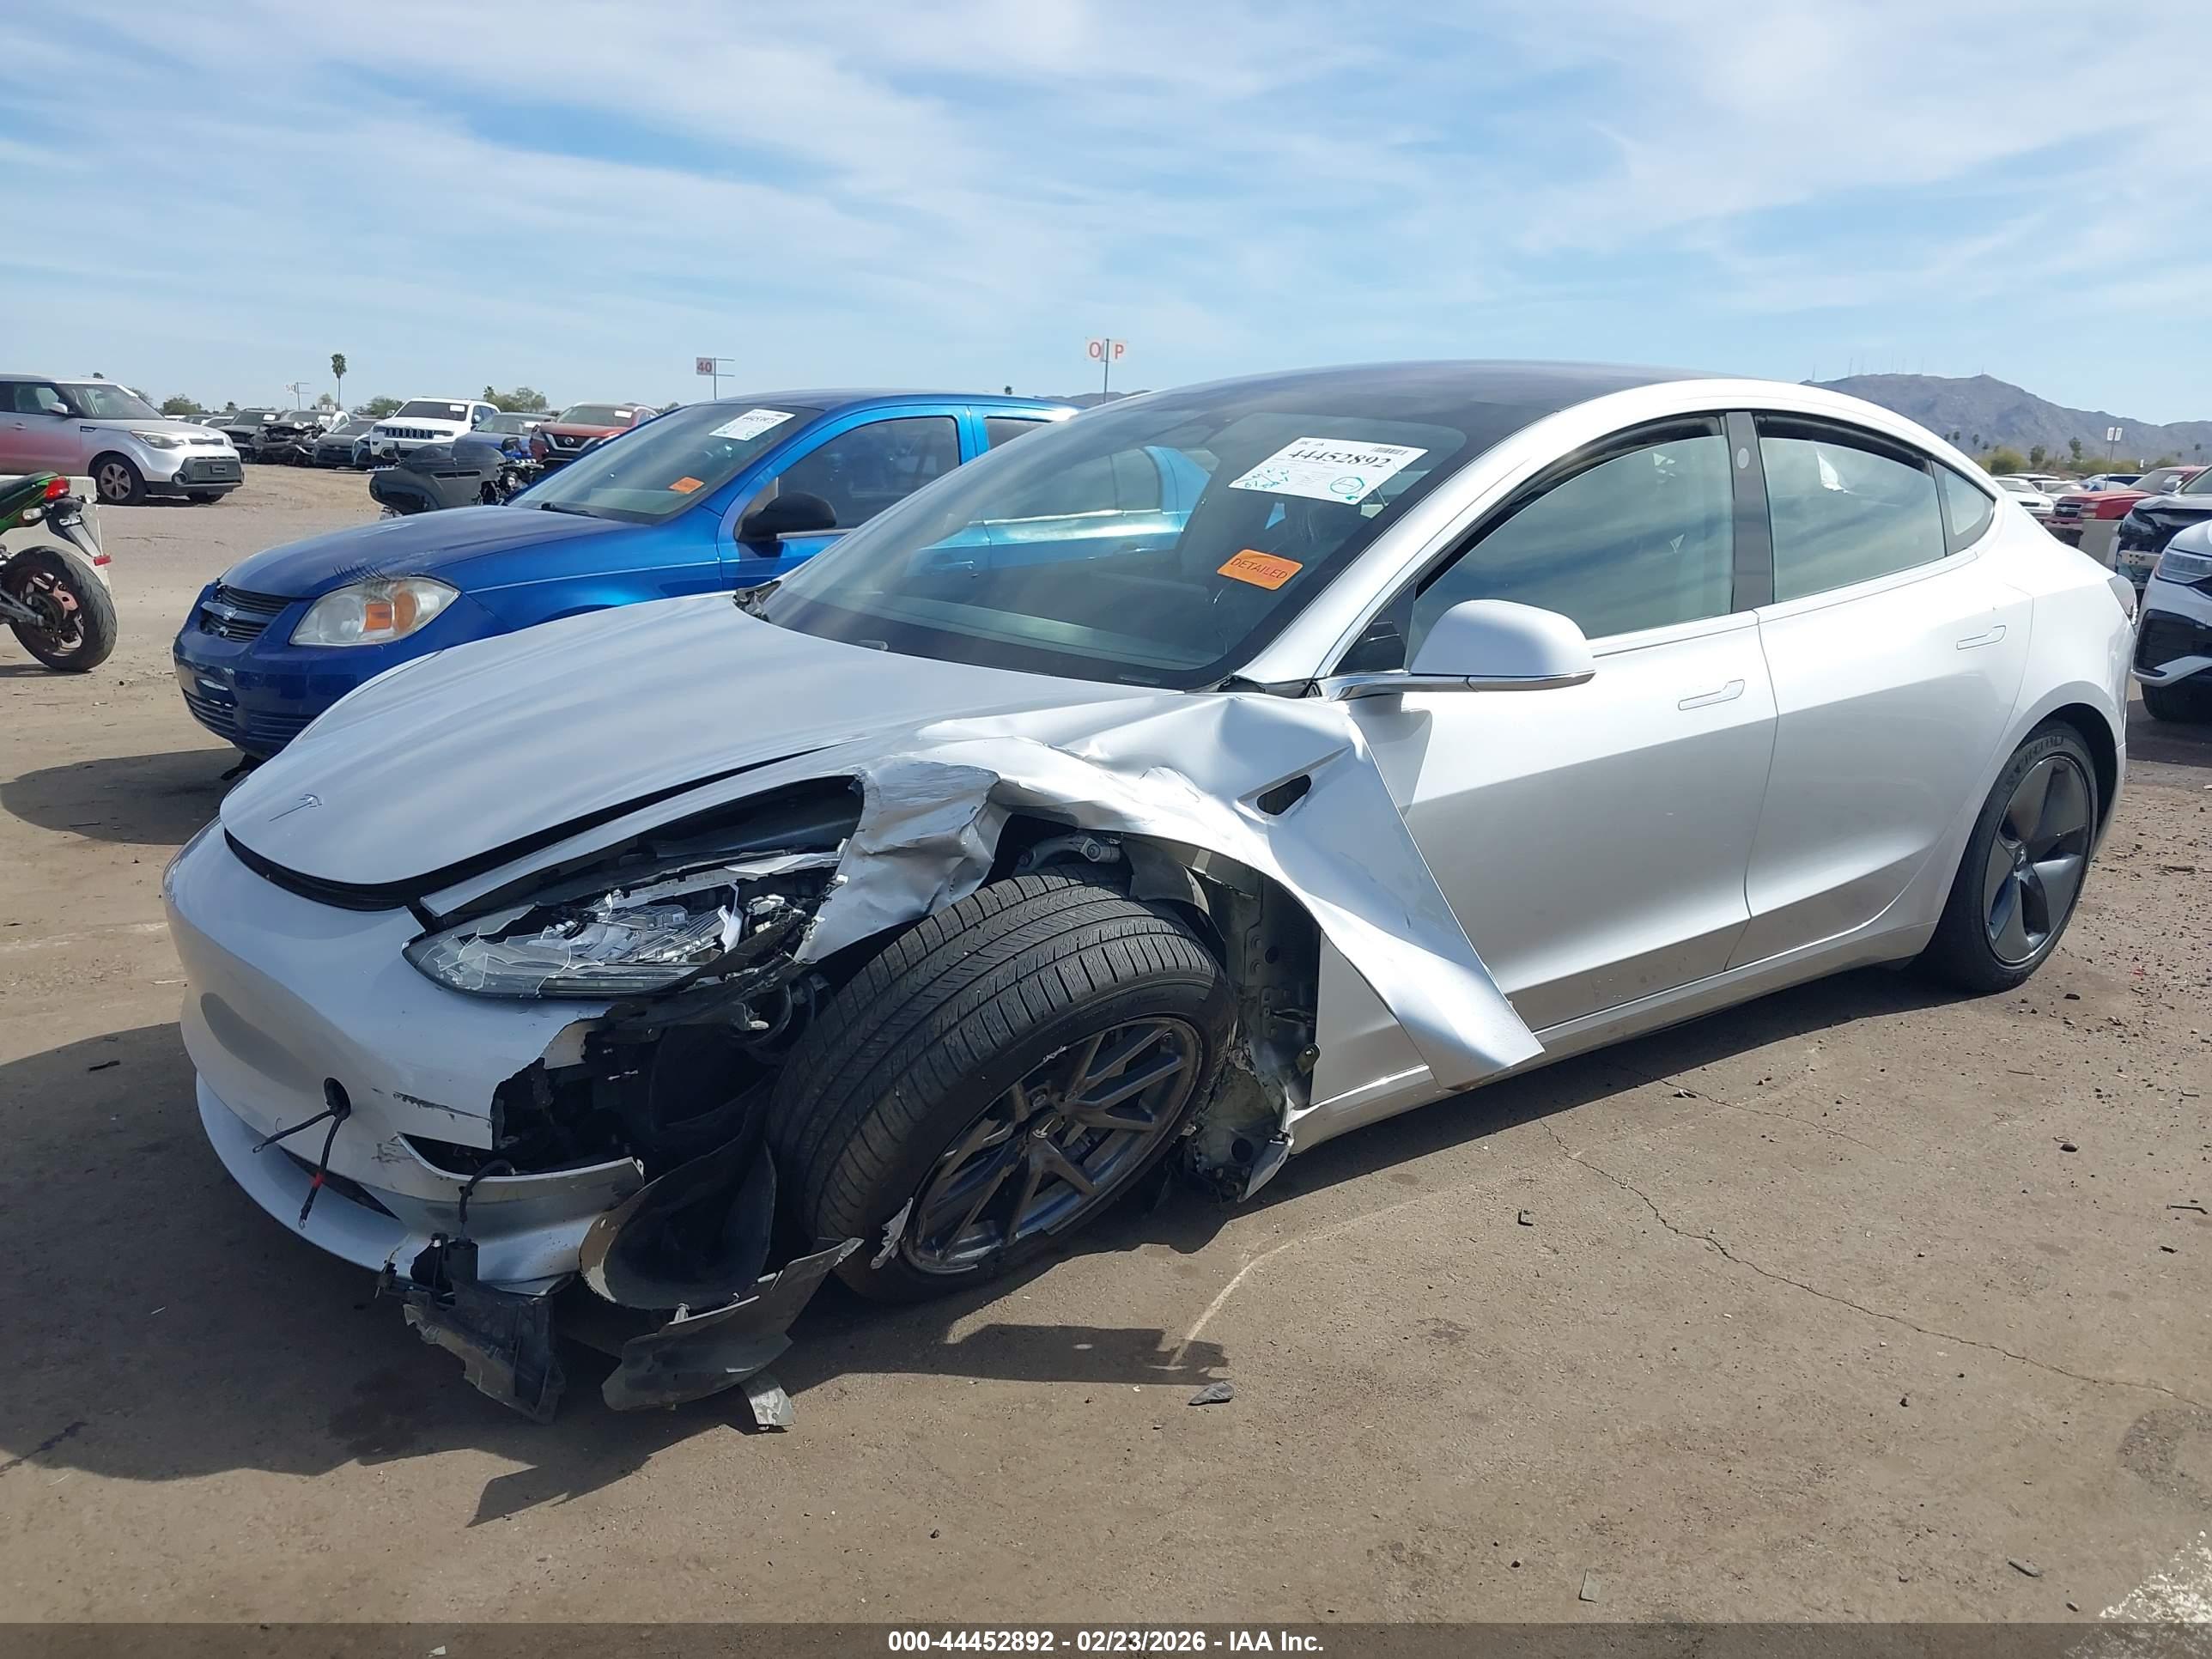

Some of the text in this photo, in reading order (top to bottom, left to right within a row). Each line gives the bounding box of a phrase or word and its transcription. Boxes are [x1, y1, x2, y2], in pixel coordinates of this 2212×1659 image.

[1115, 343, 1124, 360] P
[696, 362, 713, 373] 40
[1288, 449, 1391, 468] 44452892
[1231, 557, 1288, 579] DETAILED
